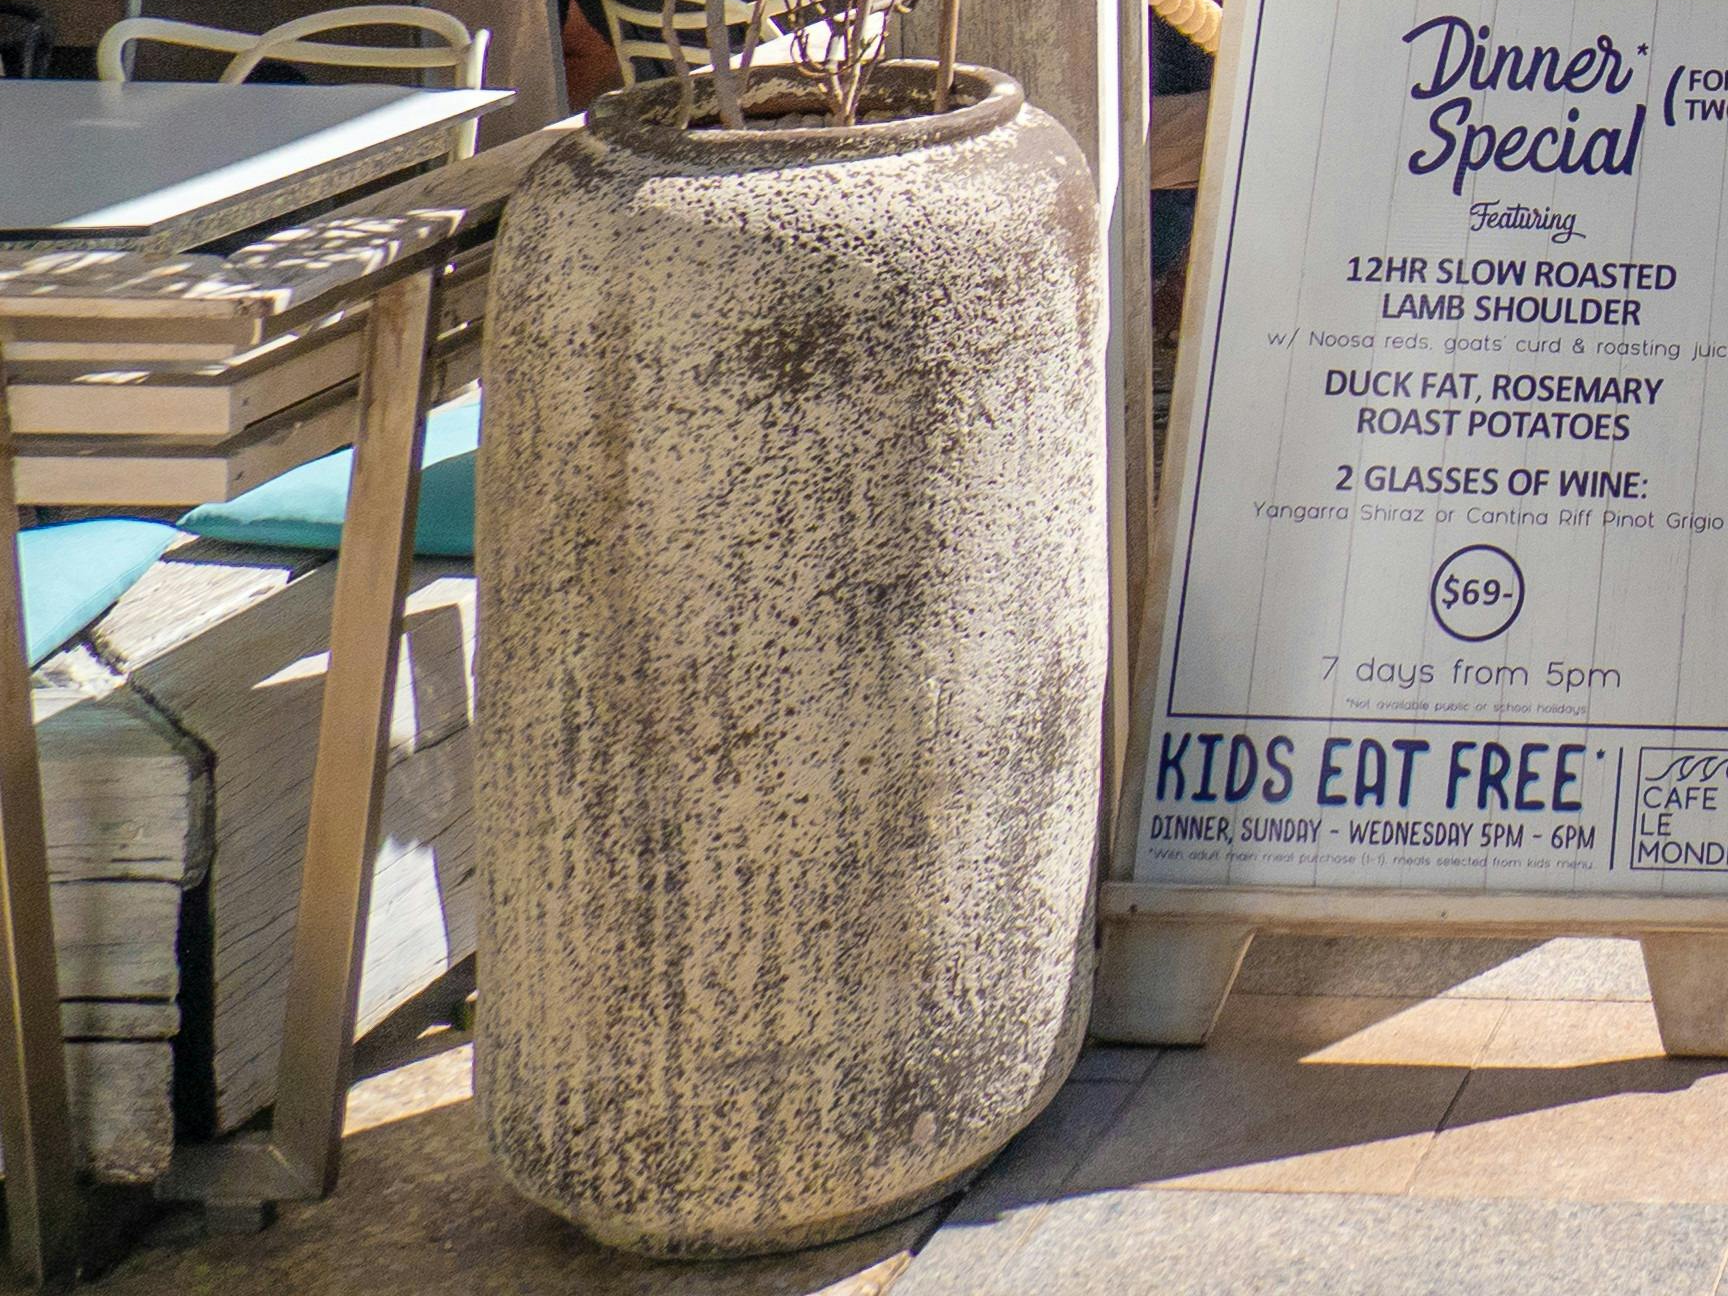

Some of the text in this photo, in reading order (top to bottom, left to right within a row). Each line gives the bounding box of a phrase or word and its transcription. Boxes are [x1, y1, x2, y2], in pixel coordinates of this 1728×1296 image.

[1408, 96, 1646, 196] Special
[1470, 199, 1586, 245] Featuring
[1346, 256, 1677, 290] 12HR SLOW ROASTED
[1382, 293, 1641, 326] LAMB SHOULDER
[1309, 330, 1374, 349] Noosa
[1516, 337, 1561, 356] curd
[1572, 339, 1586, 356] &
[1597, 339, 1680, 360] roasting
[1324, 369, 1664, 404] DUCK FAT, ROSEMARY
[1358, 408, 1631, 441] ROAST POTATOES
[1336, 465, 1649, 499] 2 GLASSES OF WINE:
[1254, 500, 1724, 534] Yangarra Shiraz or Cantina Riff Pinot Grigio
[1441, 574, 1514, 608] $69-
[1321, 656, 1621, 694] 7 days from 5pm
[1156, 733, 1295, 804] KIDS
[1317, 737, 1430, 806] EAT
[1642, 786, 1719, 812] CAFE
[1150, 815, 1235, 848] DINNER,
[1240, 818, 1322, 844] SUNDAY
[1349, 820, 1474, 847] WEDNESDAY
[1480, 822, 1524, 848] 5PM
[1551, 824, 1596, 850] 6PM
[1639, 812, 1672, 837] LE
[1299, 853, 1356, 866] purchase
[1393, 855, 1431, 866] meals
[1436, 856, 1487, 867] selected
[1492, 857, 1522, 868] from
[1526, 857, 1551, 869] kids
